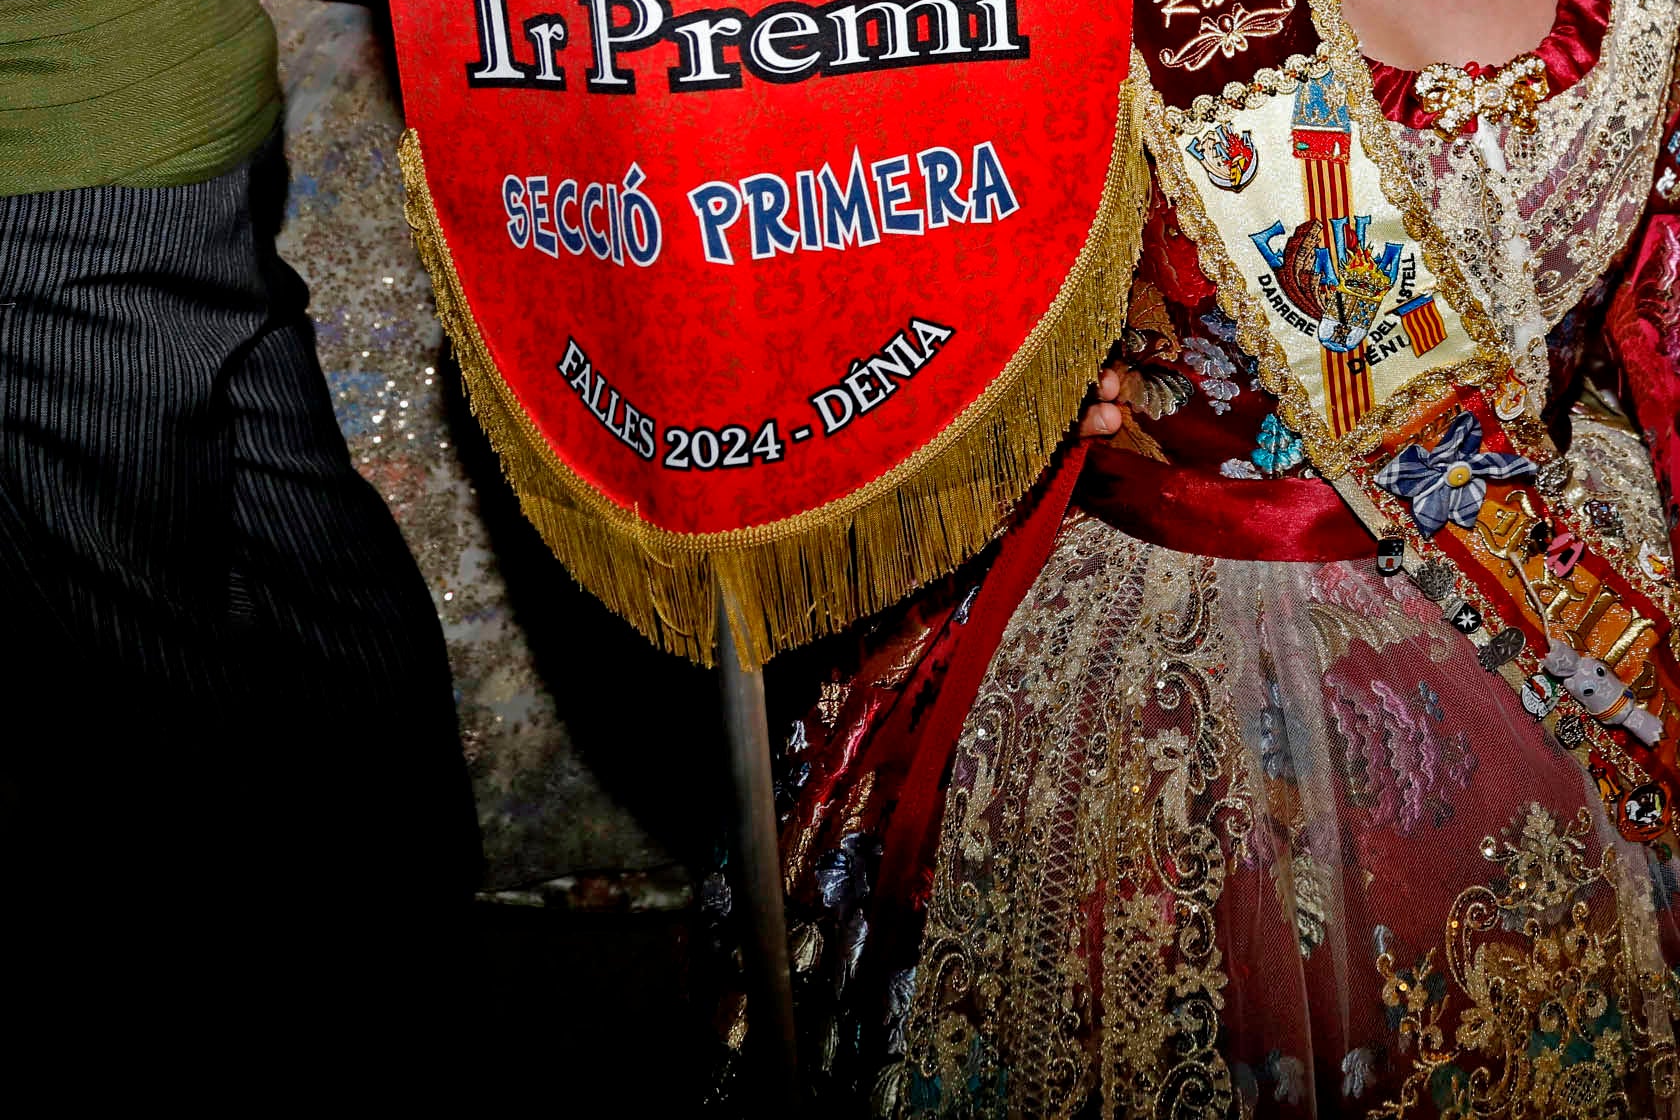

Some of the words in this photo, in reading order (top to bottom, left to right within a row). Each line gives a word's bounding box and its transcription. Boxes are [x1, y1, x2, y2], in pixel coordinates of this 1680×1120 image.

[503, 161, 662, 268] SECCIÓ
[687, 140, 1020, 265] PRIMERA
[1257, 274, 1318, 338] DARRERE
[1369, 318, 1398, 345] DEL
[1396, 251, 1416, 306] STELL
[558, 339, 656, 463] FALLES
[664, 419, 783, 471] 2024
[809, 316, 953, 440] DÉNIA
[1346, 335, 1412, 376] DÉNI
